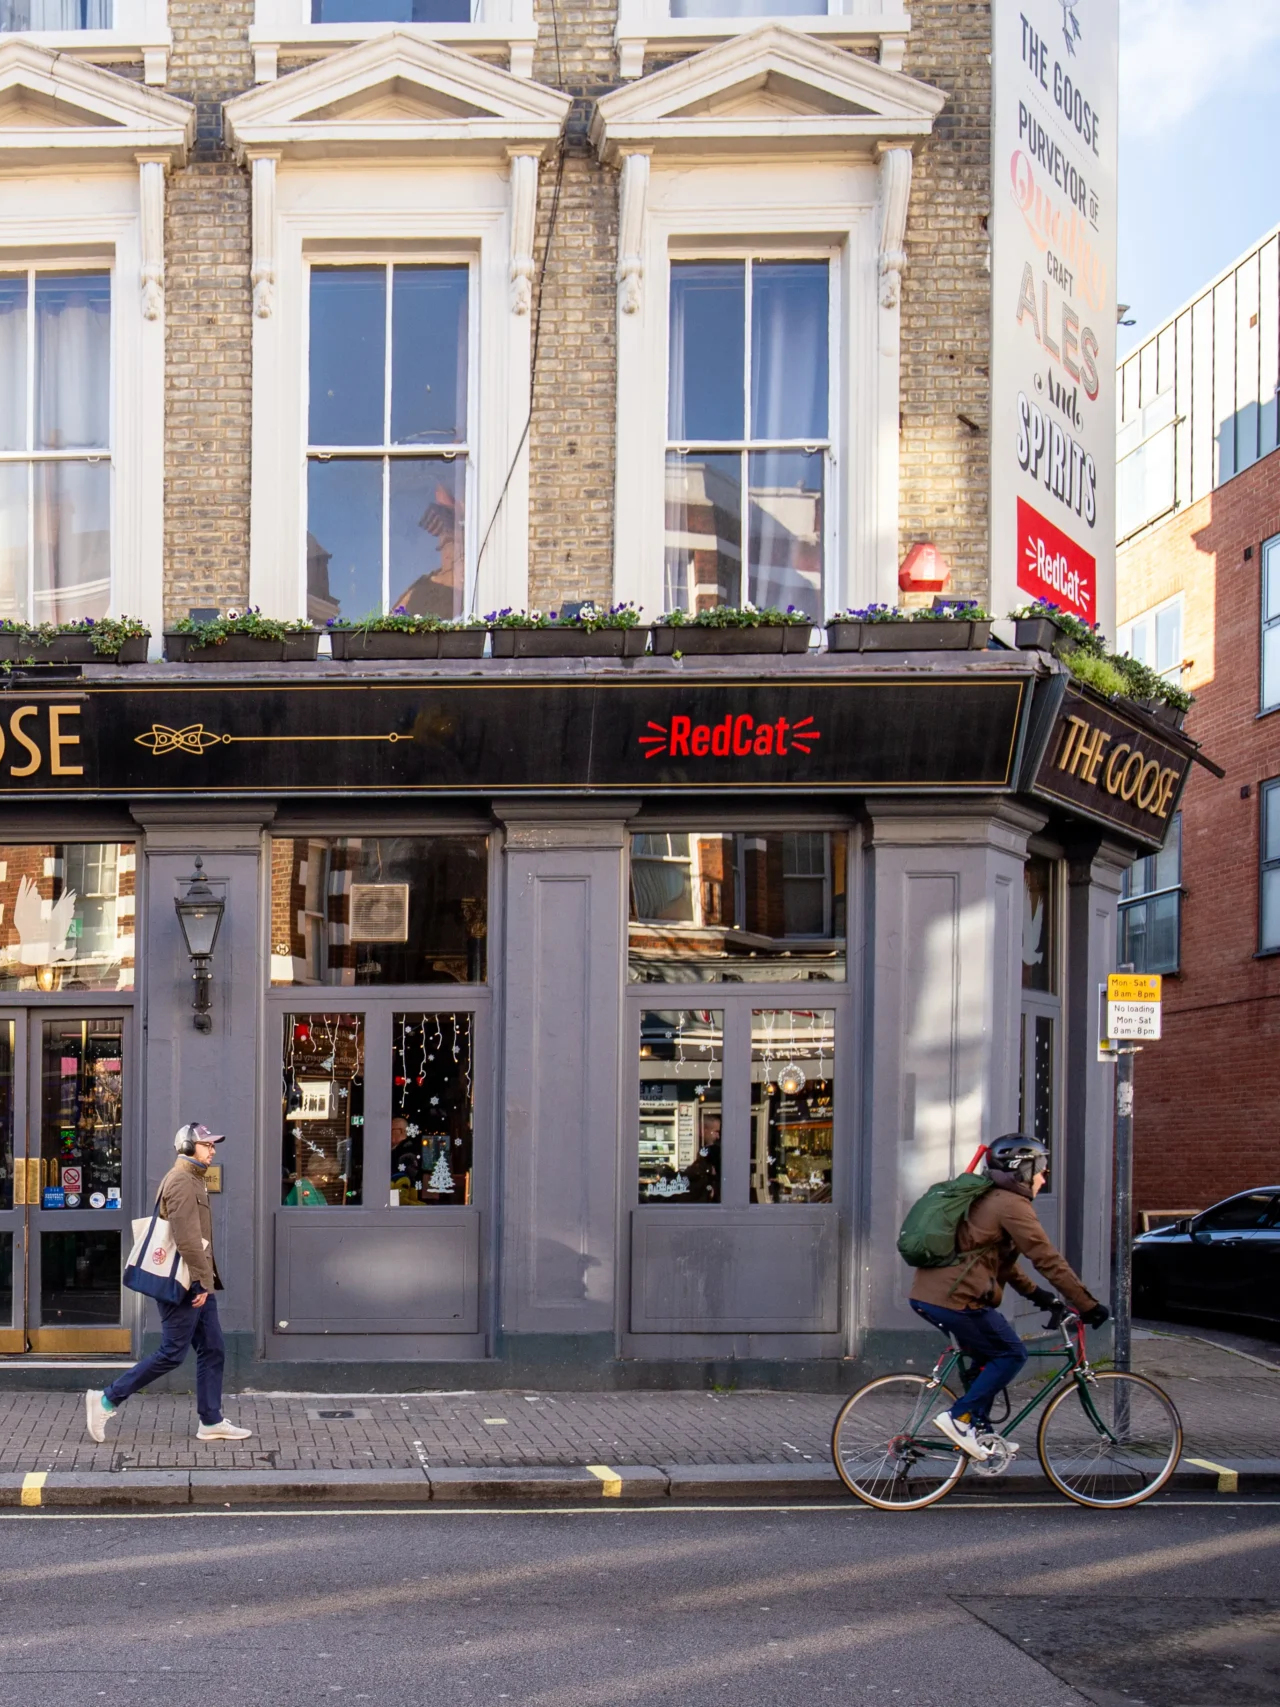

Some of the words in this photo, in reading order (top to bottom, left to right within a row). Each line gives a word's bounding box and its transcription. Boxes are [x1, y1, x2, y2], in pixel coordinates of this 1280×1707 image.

[1020, 12, 1048, 91] THE
[1054, 61, 1100, 158] GOOSE
[1019, 99, 1087, 218] PURVEYOR
[1089, 198, 1099, 223] OF
[1010, 149, 1107, 313] Quality
[1046, 250, 1073, 298] CRAFT
[1016, 261, 1099, 401] ALES
[1034, 366, 1084, 433] And
[1016, 390, 1097, 529] SPIRITS
[1036, 537, 1081, 607] RedCat
[669, 713, 790, 757] RedCat
[1058, 714, 1112, 785] THE
[1106, 742, 1180, 820] GOOSE
[1111, 979, 1128, 987] Mon
[1133, 979, 1147, 987] Sat
[1127, 1005, 1155, 1013] loading
[1116, 1016, 1133, 1024] Mon
[1138, 1016, 1152, 1024] Sat
